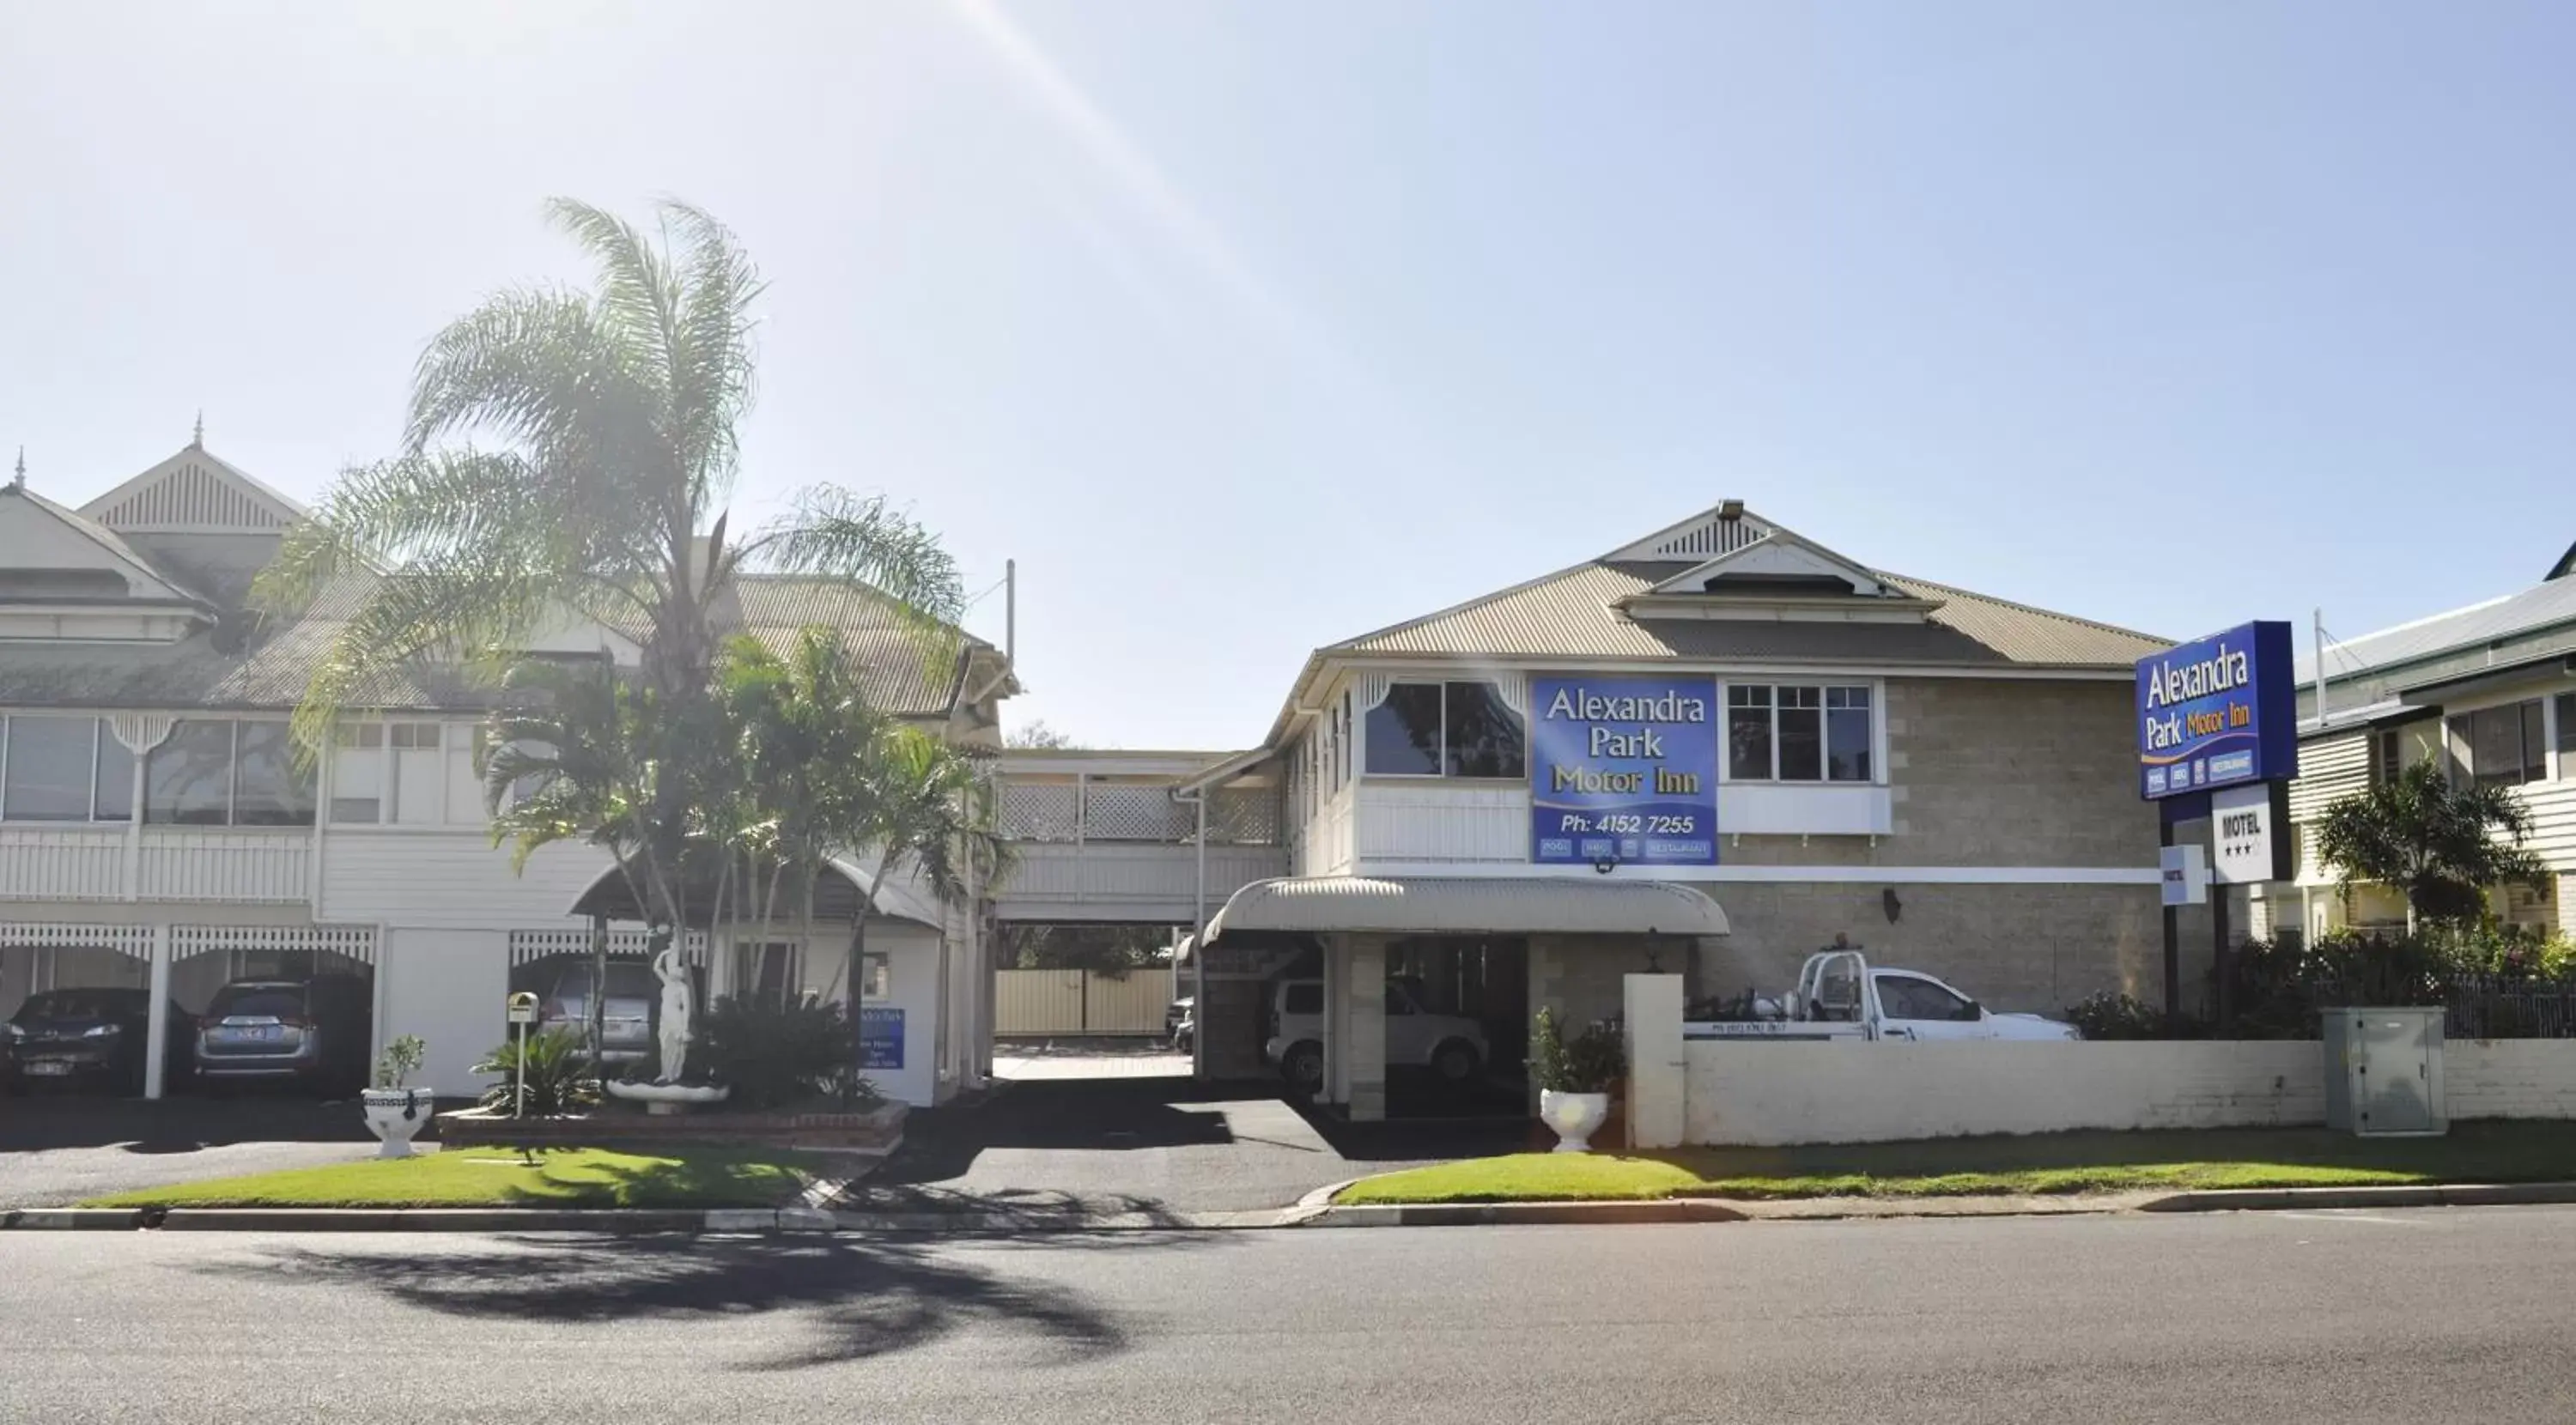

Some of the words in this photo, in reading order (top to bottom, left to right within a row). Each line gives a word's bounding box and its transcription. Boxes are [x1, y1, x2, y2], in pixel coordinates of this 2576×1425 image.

[2147, 644, 2248, 710] Alexandra
[1546, 687, 1705, 722] Alexandra
[2147, 712, 2181, 750] Park
[2186, 710, 2225, 737] Motor
[2229, 701, 2250, 726] Inn
[1590, 726, 1663, 757] Park
[1552, 765, 1642, 792] Motor
[1656, 766, 1699, 793] Inn
[1561, 815, 1590, 832] Ph:
[1596, 815, 1641, 834] 4152
[1647, 816, 1694, 834] 7255
[2222, 811, 2261, 839] MOTEL
